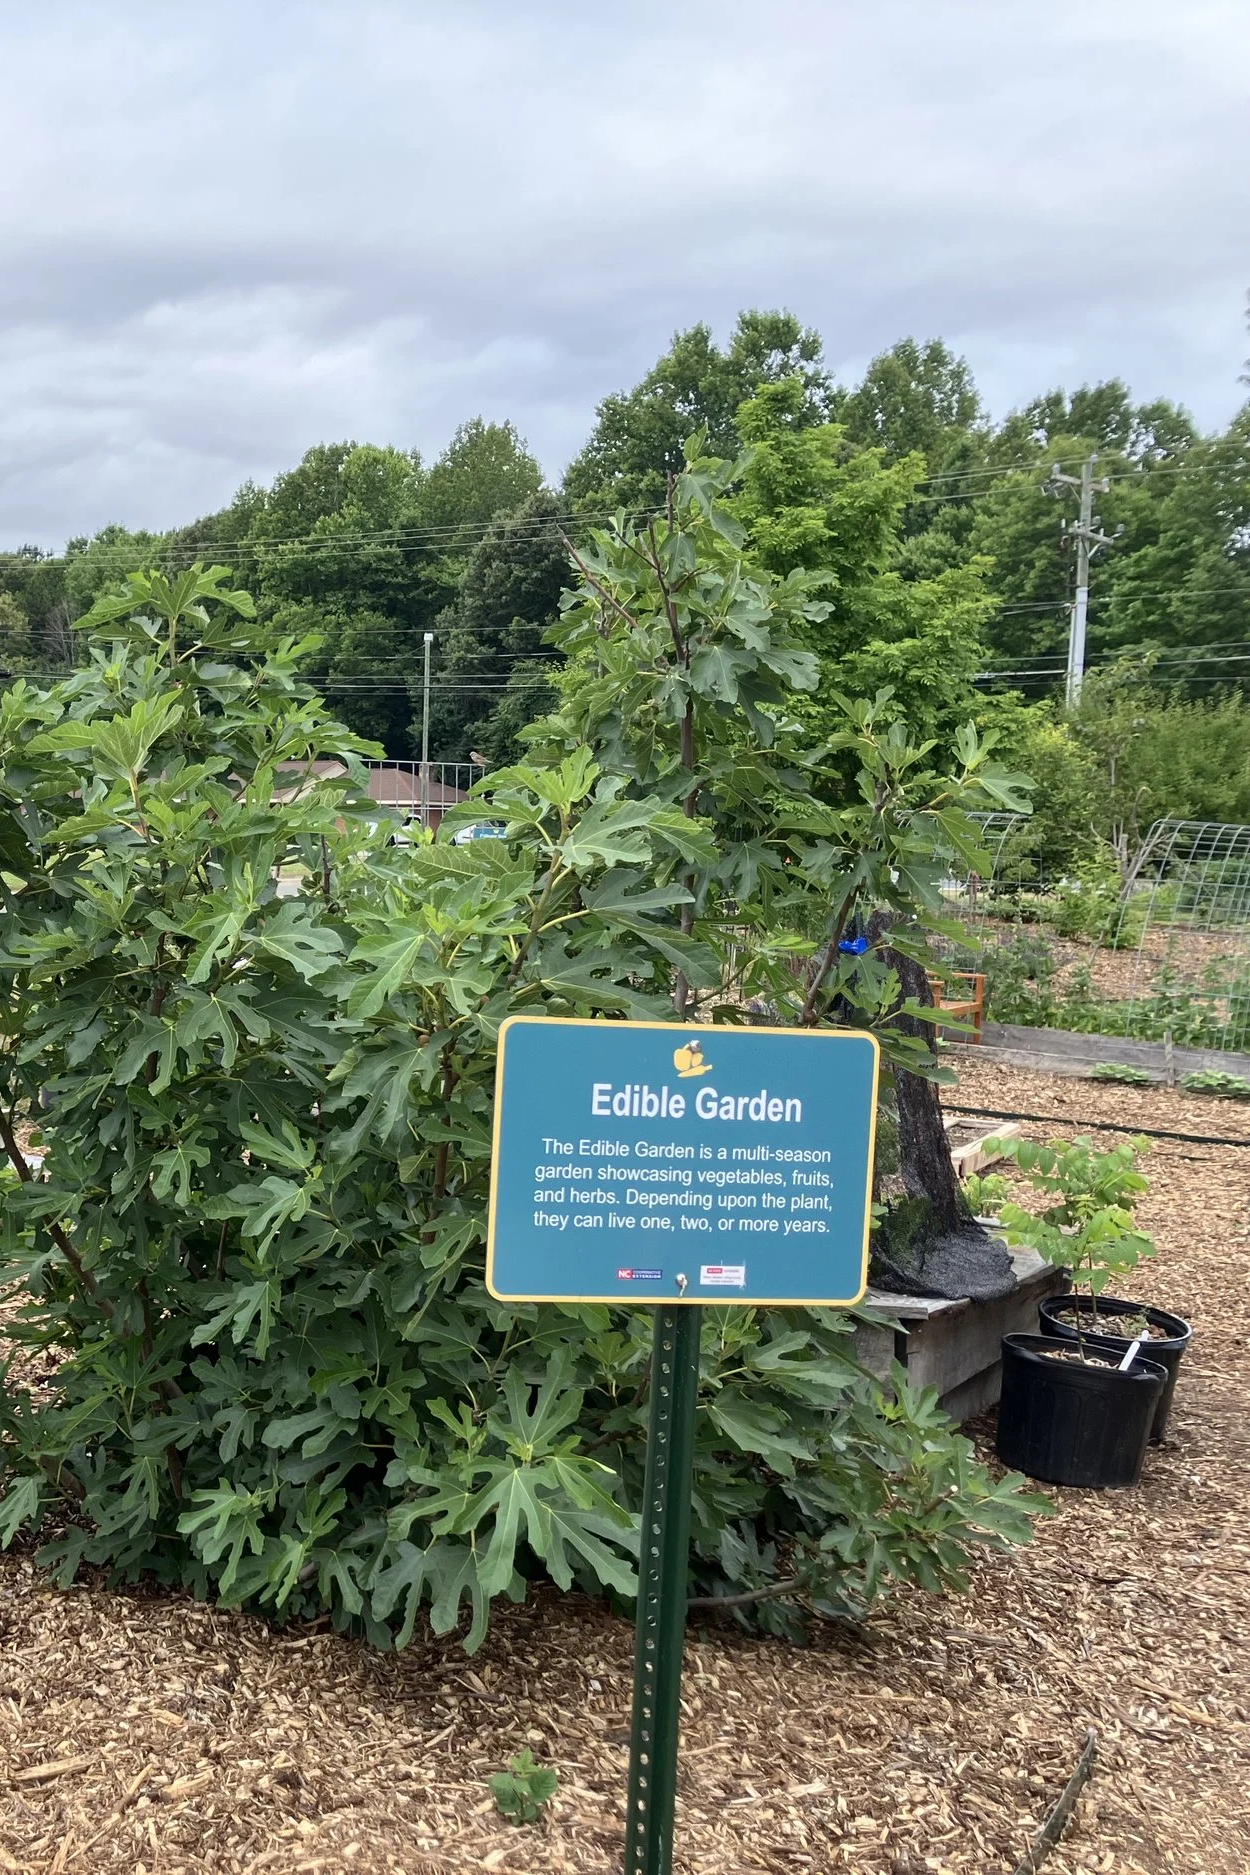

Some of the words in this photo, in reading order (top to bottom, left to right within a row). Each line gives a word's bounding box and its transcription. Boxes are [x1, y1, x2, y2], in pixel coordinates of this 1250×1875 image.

[592, 1083, 685, 1118] Edible
[696, 1087, 801, 1122] Garden
[542, 1138, 573, 1154] The
[579, 1140, 629, 1156] Edible
[635, 1141, 694, 1158] Garden
[700, 1144, 712, 1159] is
[717, 1148, 727, 1159] a
[733, 1145, 830, 1162] multi-season
[535, 1163, 592, 1182] garden
[598, 1165, 692, 1186] showcasing
[698, 1169, 786, 1187] vegetables,
[792, 1170, 833, 1188] fruits,
[534, 1187, 564, 1202] and
[571, 1188, 619, 1204] herbs.
[626, 1189, 712, 1210] Depending
[718, 1195, 756, 1210] upon
[762, 1193, 786, 1208] the
[791, 1194, 831, 1212] plant,
[534, 1211, 569, 1230] they
[574, 1215, 603, 1227] can
[609, 1213, 635, 1228] live
[641, 1217, 674, 1231] one,
[681, 1215, 712, 1232] two,
[718, 1219, 734, 1230] or
[739, 1219, 779, 1231] more
[784, 1220, 829, 1235] years.
[618, 1270, 631, 1278] NC
